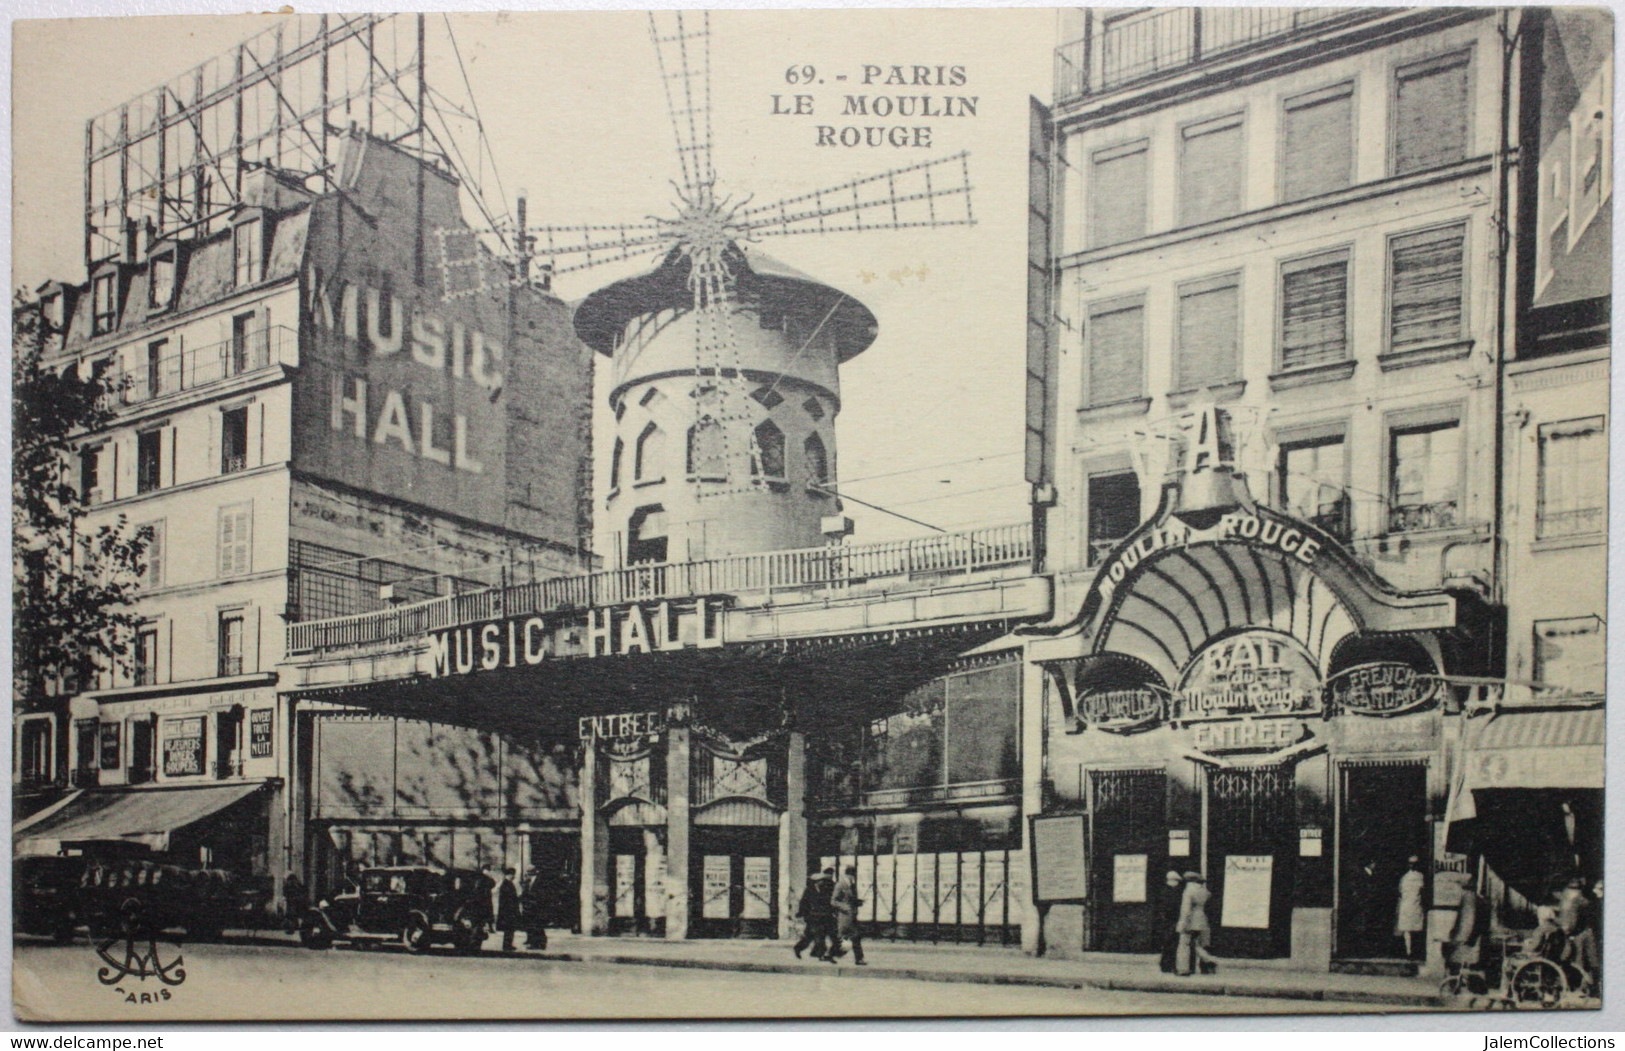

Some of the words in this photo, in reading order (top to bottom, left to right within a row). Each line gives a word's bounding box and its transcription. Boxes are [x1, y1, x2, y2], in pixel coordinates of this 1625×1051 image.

[306, 262, 504, 389] MUSIC
[330, 366, 485, 475] HALL
[1098, 524, 1192, 600] MOULIN
[1220, 513, 1321, 564] ROUGE
[428, 616, 545, 679] MUSIC
[587, 598, 723, 658] HALL
[1202, 636, 1287, 675] BAL
[1184, 685, 1246, 716] Moulin
[1247, 683, 1304, 714] Rouge
[1349, 667, 1417, 689] FRENCH
[251, 742, 271, 756] NUIT
